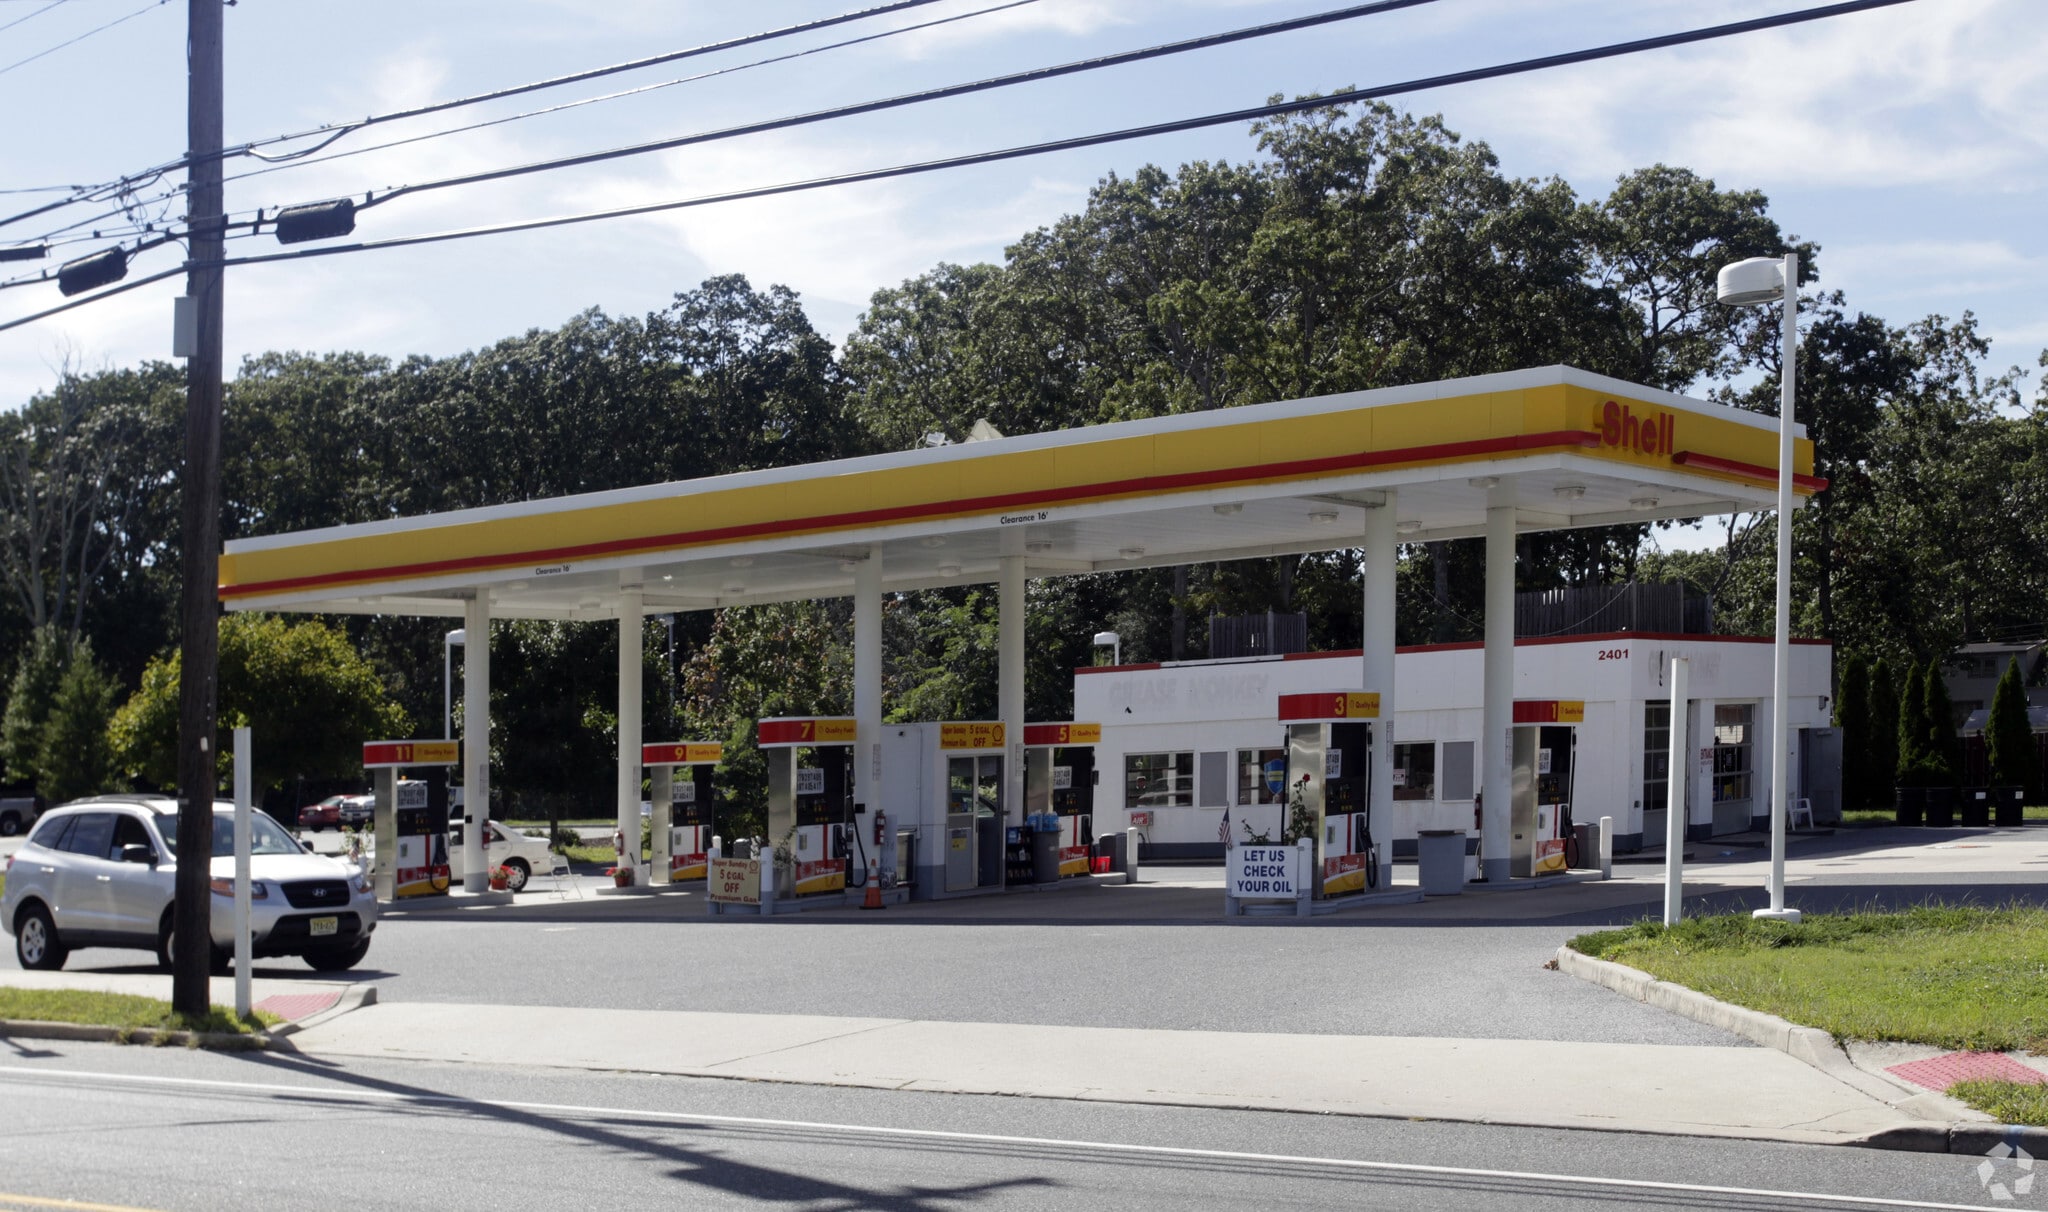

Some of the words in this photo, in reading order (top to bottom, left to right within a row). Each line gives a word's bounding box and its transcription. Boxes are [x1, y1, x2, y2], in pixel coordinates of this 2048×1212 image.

[1602, 400, 1674, 455] Shell
[1000, 514, 1035, 524] Clearance
[1598, 648, 1629, 660] 2401
[1334, 696, 1344, 715] 3
[1551, 703, 1557, 720] 1
[800, 722, 811, 739] 7
[1058, 727, 1067, 741] 5
[973, 737, 986, 747] OFF
[396, 745, 411, 761] 11
[674, 746, 684, 760] 9
[1244, 850, 1265, 861] LET
[1269, 850, 1285, 862] US
[720, 869, 725, 880] 5
[1243, 865, 1285, 877] CHECK
[724, 882, 740, 893] OFF
[1237, 880, 1270, 892] YOUR
[1272, 881, 1292, 893] OIL
